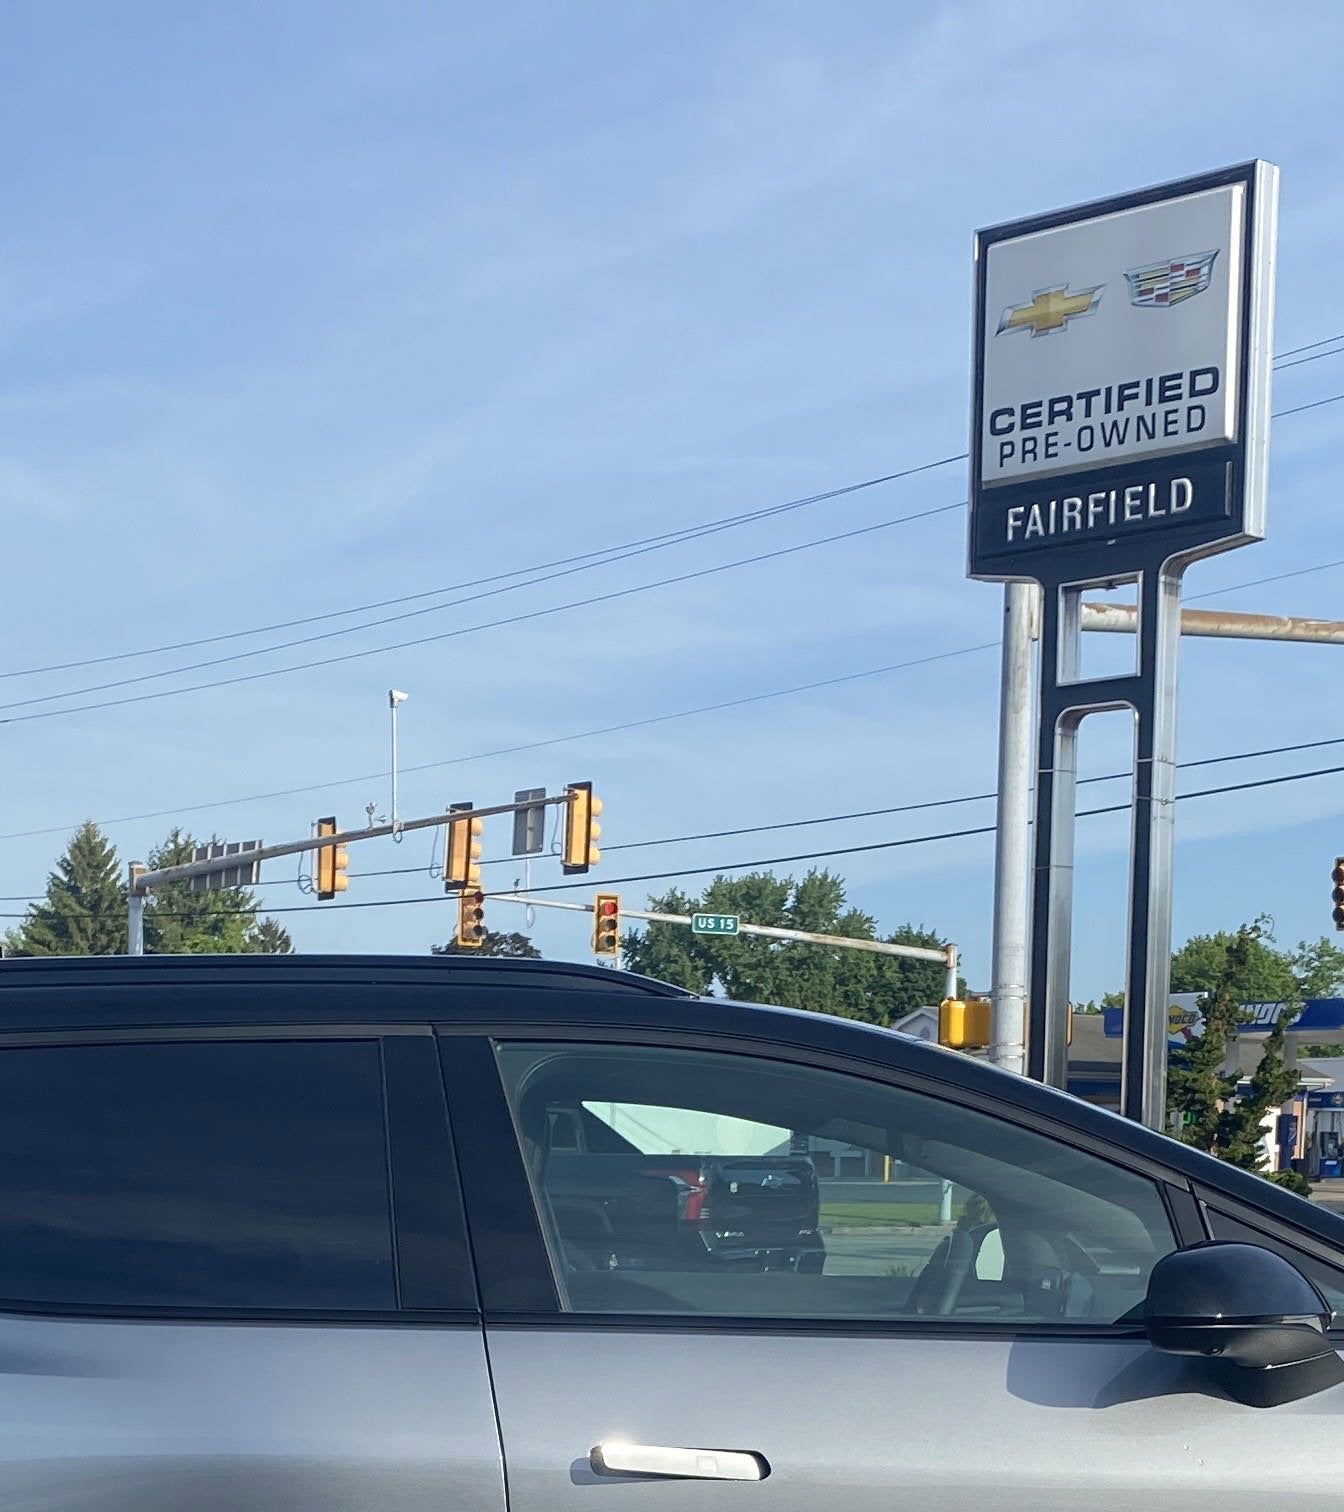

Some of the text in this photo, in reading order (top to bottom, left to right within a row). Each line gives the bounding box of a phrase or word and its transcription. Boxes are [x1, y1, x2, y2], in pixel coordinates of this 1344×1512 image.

[989, 366, 1220, 437] CERTIFIED
[999, 404, 1206, 468] PRE-OWNED
[1006, 476, 1194, 542] FAIRFIELD
[698, 917, 735, 930] US 15
